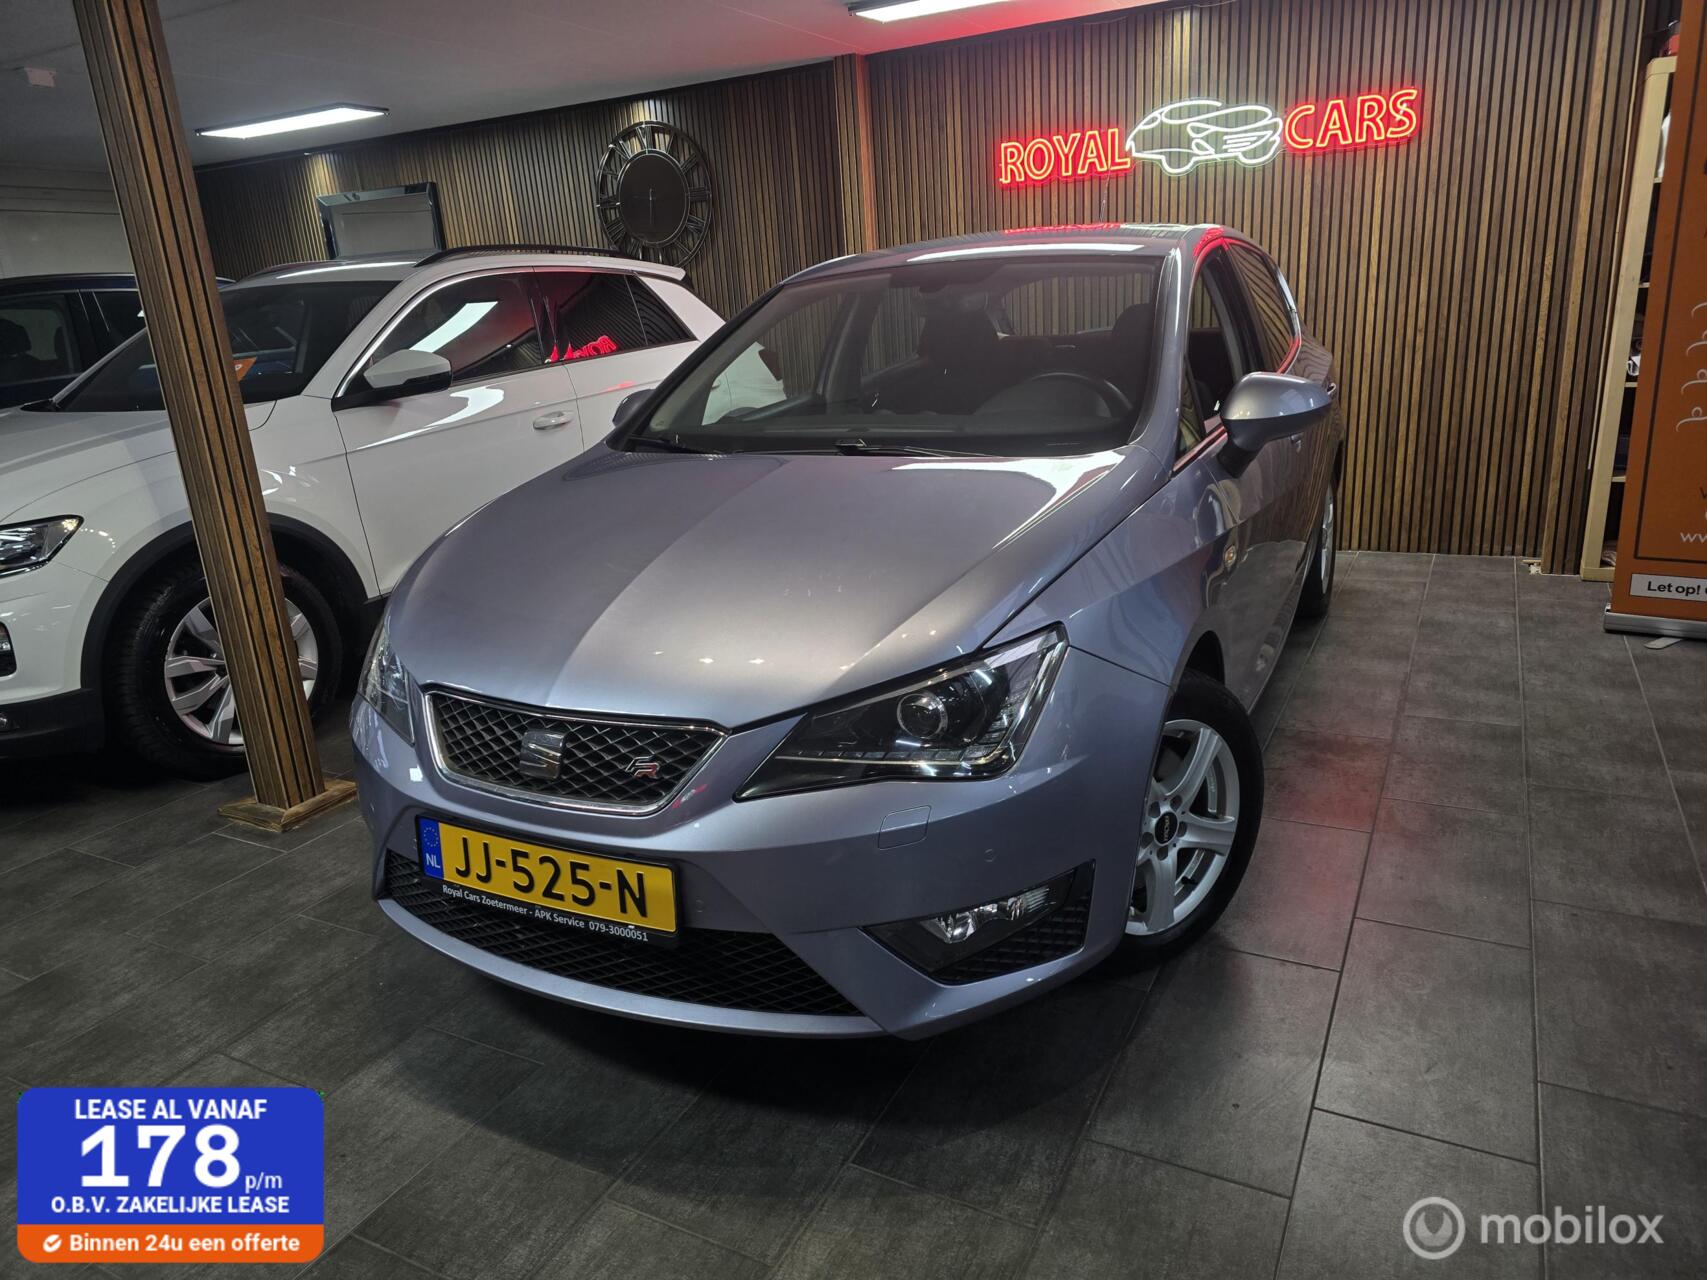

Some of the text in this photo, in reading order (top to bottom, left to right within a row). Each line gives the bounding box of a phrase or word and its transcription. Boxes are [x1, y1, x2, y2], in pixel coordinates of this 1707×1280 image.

[1000, 89, 1418, 184] ROYAL CARS
[1647, 581, 1672, 593] Let
[1675, 584, 1701, 597] op!
[425, 853, 441, 868] NL
[455, 837, 648, 918] JJ-525-N
[442, 884, 463, 898] Royal
[464, 891, 481, 903] Cars
[481, 895, 527, 915] Zoetermeer
[534, 909, 552, 921] APK
[553, 914, 585, 929] Service
[588, 921, 648, 942] 079-3000051
